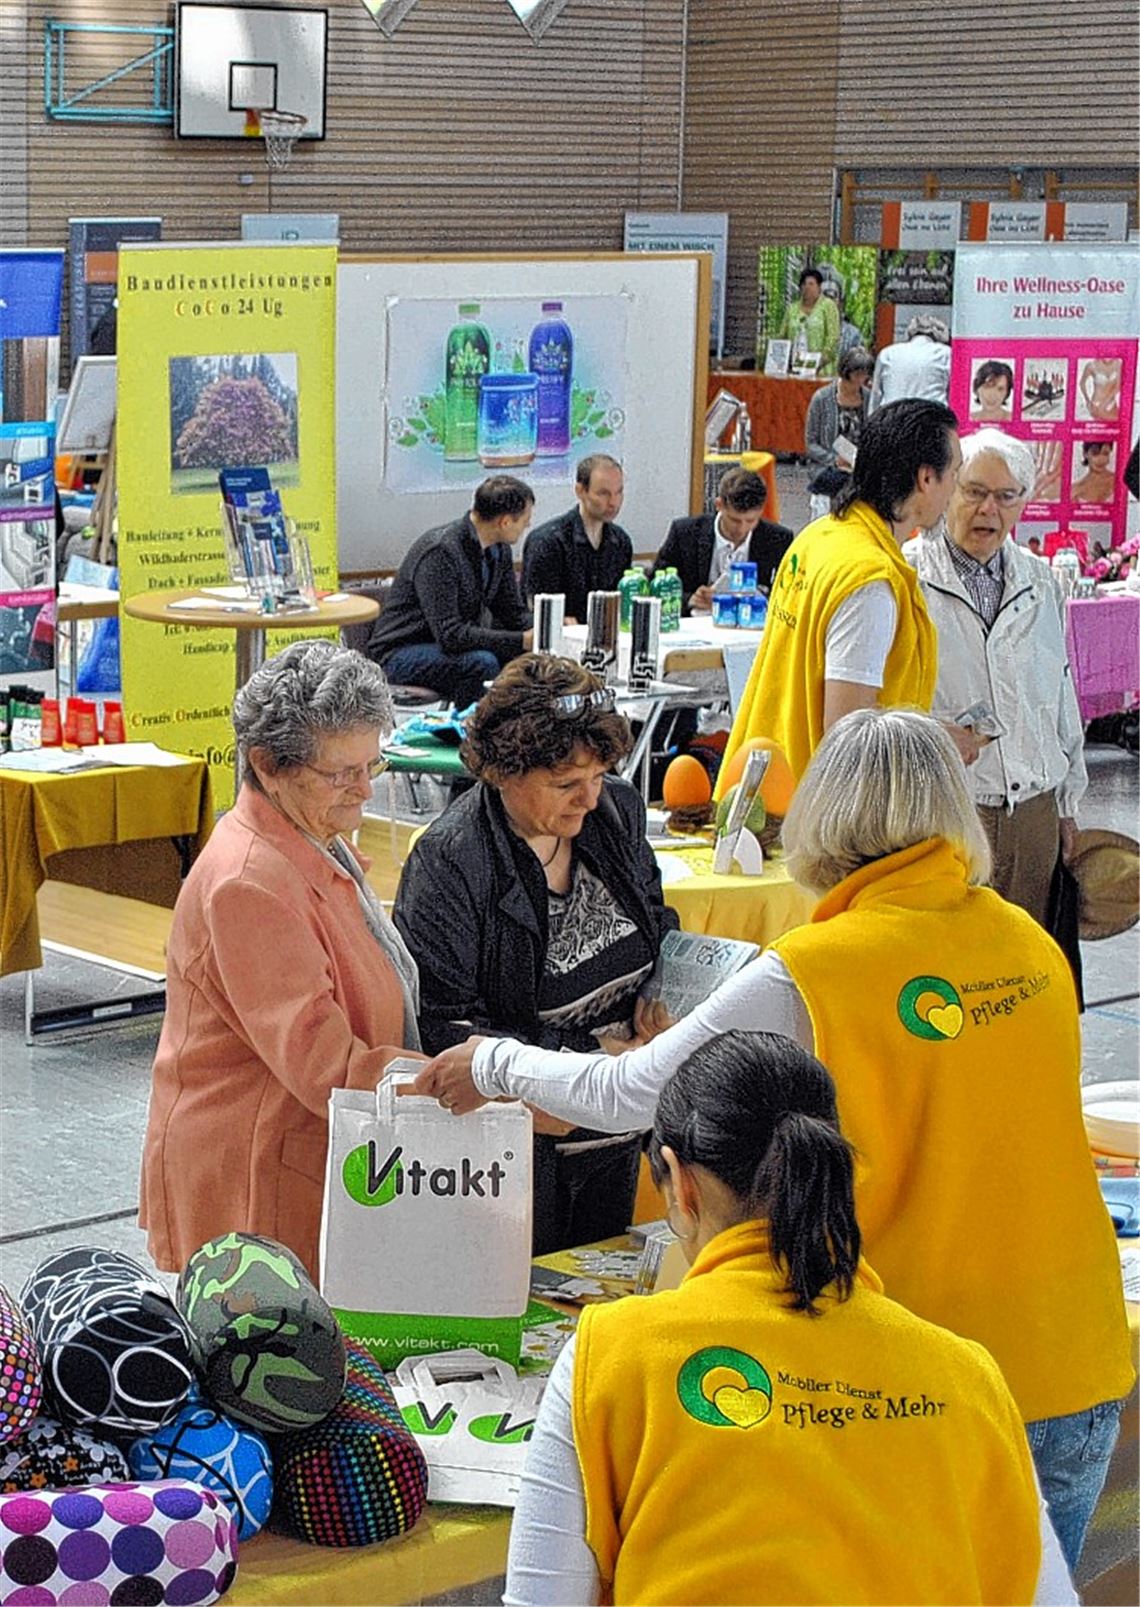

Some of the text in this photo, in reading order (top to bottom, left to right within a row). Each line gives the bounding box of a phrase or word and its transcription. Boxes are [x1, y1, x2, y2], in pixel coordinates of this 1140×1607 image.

[127, 272, 333, 291] Baudienstleistungen
[976, 277, 1125, 293] Ihre Wellness-Oase
[1013, 303, 1085, 319] zu Hause
[970, 993, 1018, 1026] Pflege
[1018, 986, 1030, 1001] &
[781, 1393, 947, 1429] Pflege & Mehr
